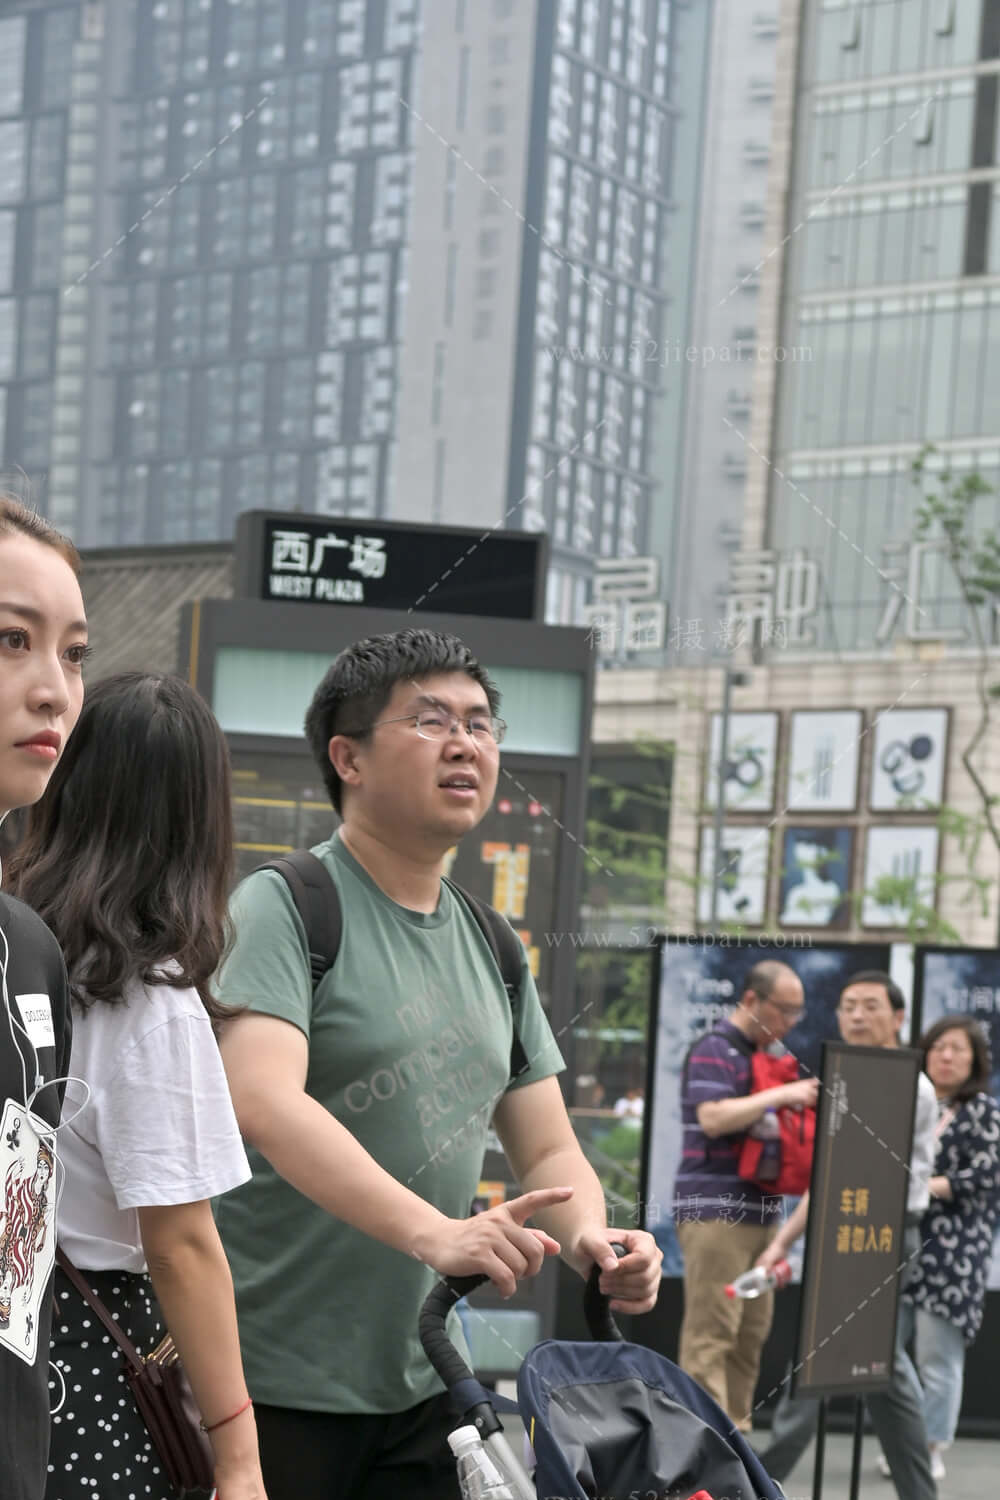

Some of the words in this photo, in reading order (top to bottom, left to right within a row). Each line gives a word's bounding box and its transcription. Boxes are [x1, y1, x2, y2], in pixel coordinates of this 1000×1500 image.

[271, 530, 387, 578] 西广场
[269, 575, 313, 598] WEST
[315, 578, 364, 601] PLAZA
